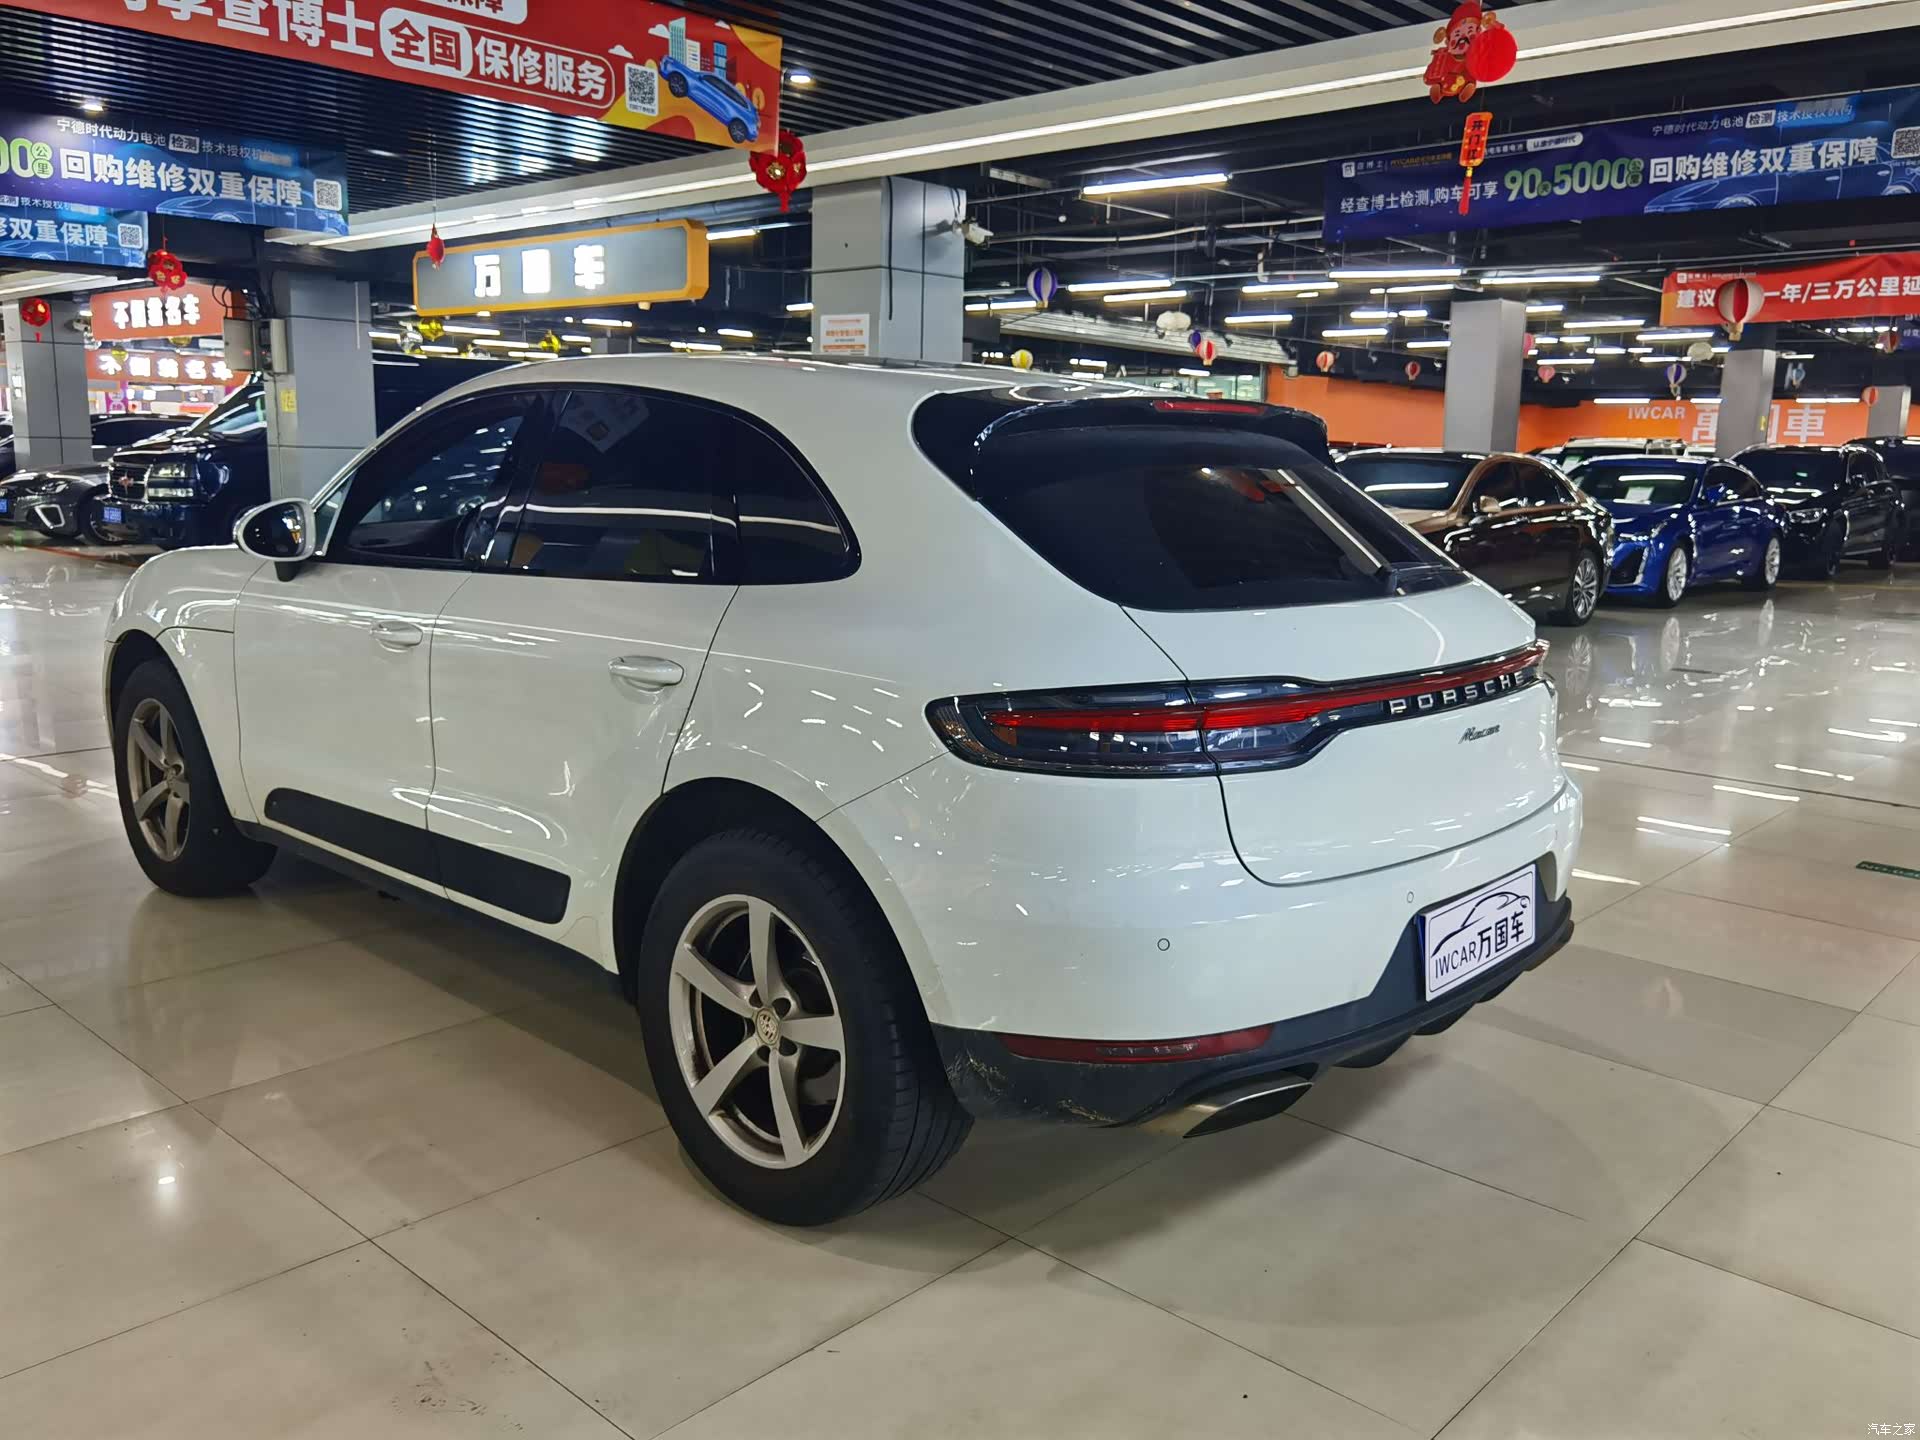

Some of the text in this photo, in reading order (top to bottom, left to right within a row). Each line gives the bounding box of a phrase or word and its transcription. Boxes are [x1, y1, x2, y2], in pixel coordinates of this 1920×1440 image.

[123, 0, 607, 100] 查博士 全国 保修服务
[57, 119, 167, 147] 宁德时代动力电池
[171, 135, 199, 152] 检测
[1748, 111, 1774, 126] 检测
[59, 148, 304, 208] 回购维修双重保障
[1649, 136, 1879, 185] 回购维修双重保障
[1676, 288, 1716, 309] 建议
[1763, 275, 1920, 304] 一年/三万公里延
[1627, 406, 1685, 420] IWCAR
[1389, 670, 1525, 715] PORSCHE
